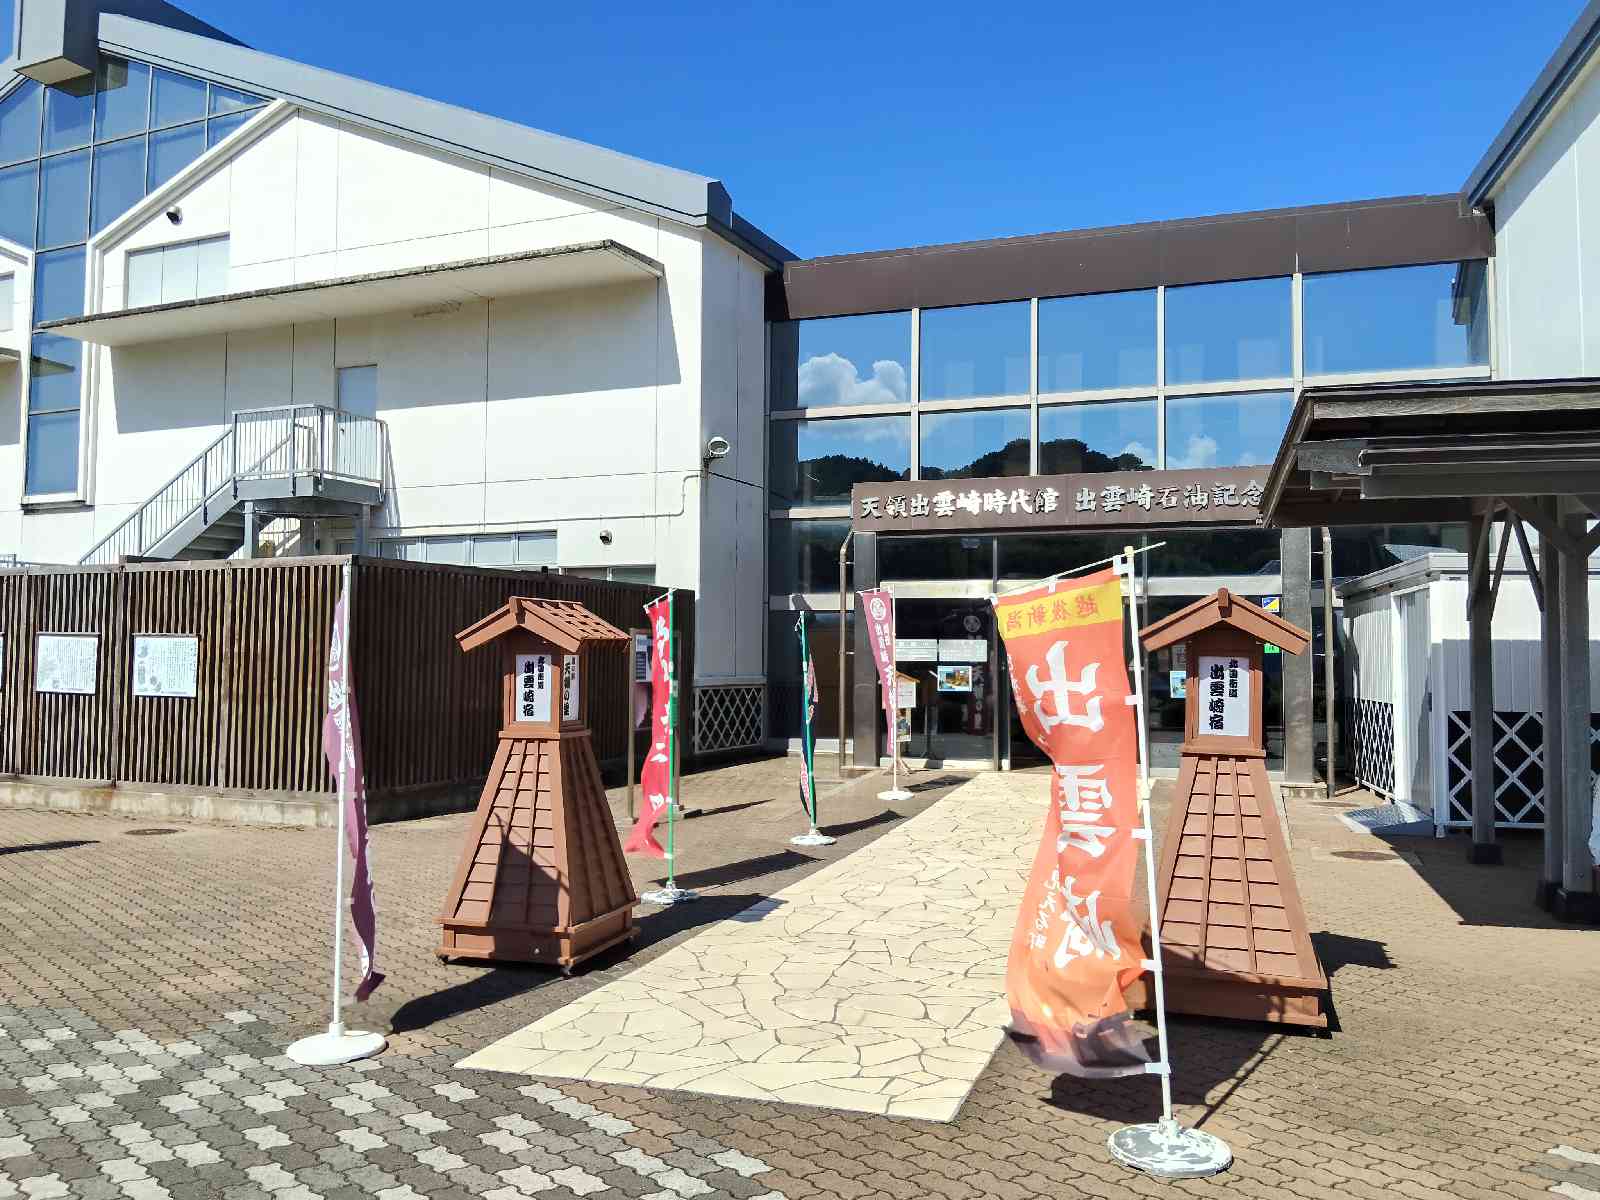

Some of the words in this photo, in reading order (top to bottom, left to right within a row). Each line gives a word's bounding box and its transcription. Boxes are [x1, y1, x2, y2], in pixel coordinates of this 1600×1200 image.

[860, 488, 1060, 518] 天領出雲崎時代館
[523, 660, 535, 717] 出雲崎宿
[1209, 663, 1225, 730] 出雲崎宿
